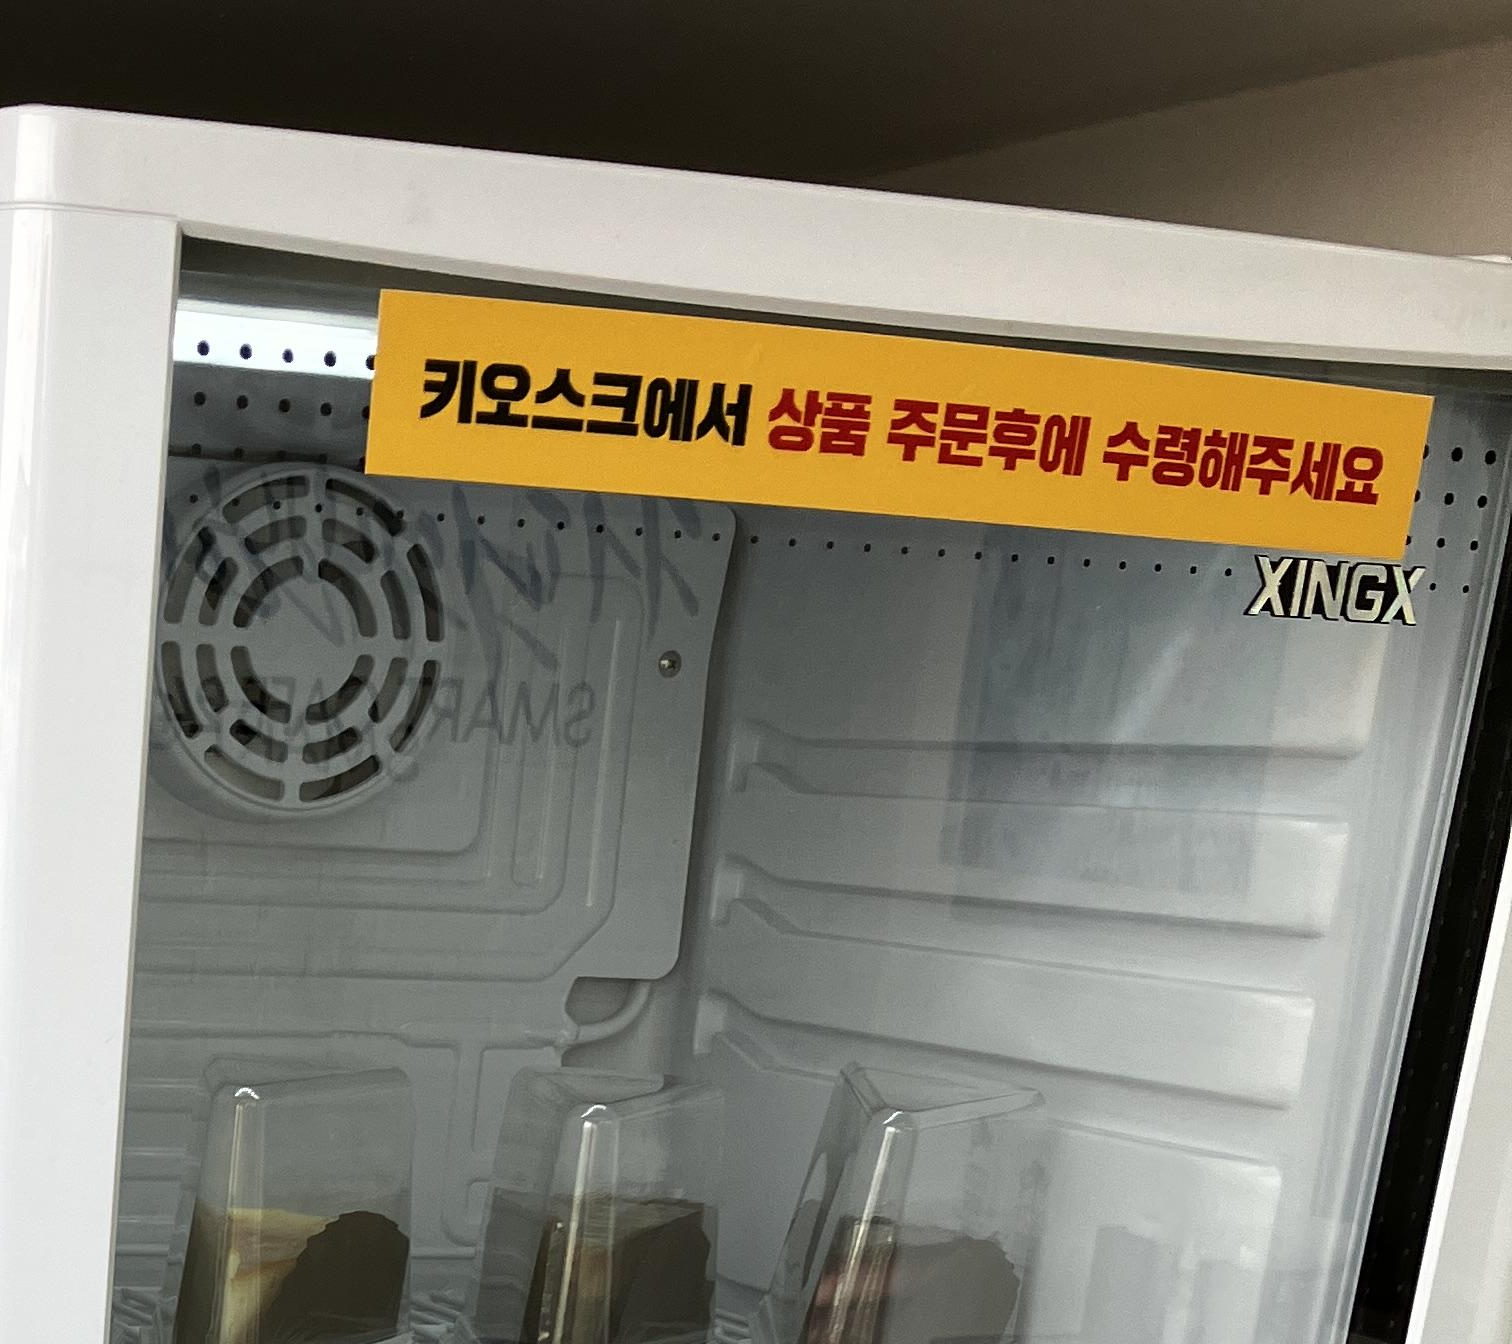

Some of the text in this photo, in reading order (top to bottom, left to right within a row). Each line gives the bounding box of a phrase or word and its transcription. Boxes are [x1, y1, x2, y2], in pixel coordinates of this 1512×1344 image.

[419, 358, 1385, 506] 키오스크에서 상품 주문후에 수령해주세요
[1243, 555, 1425, 626] XINGX
